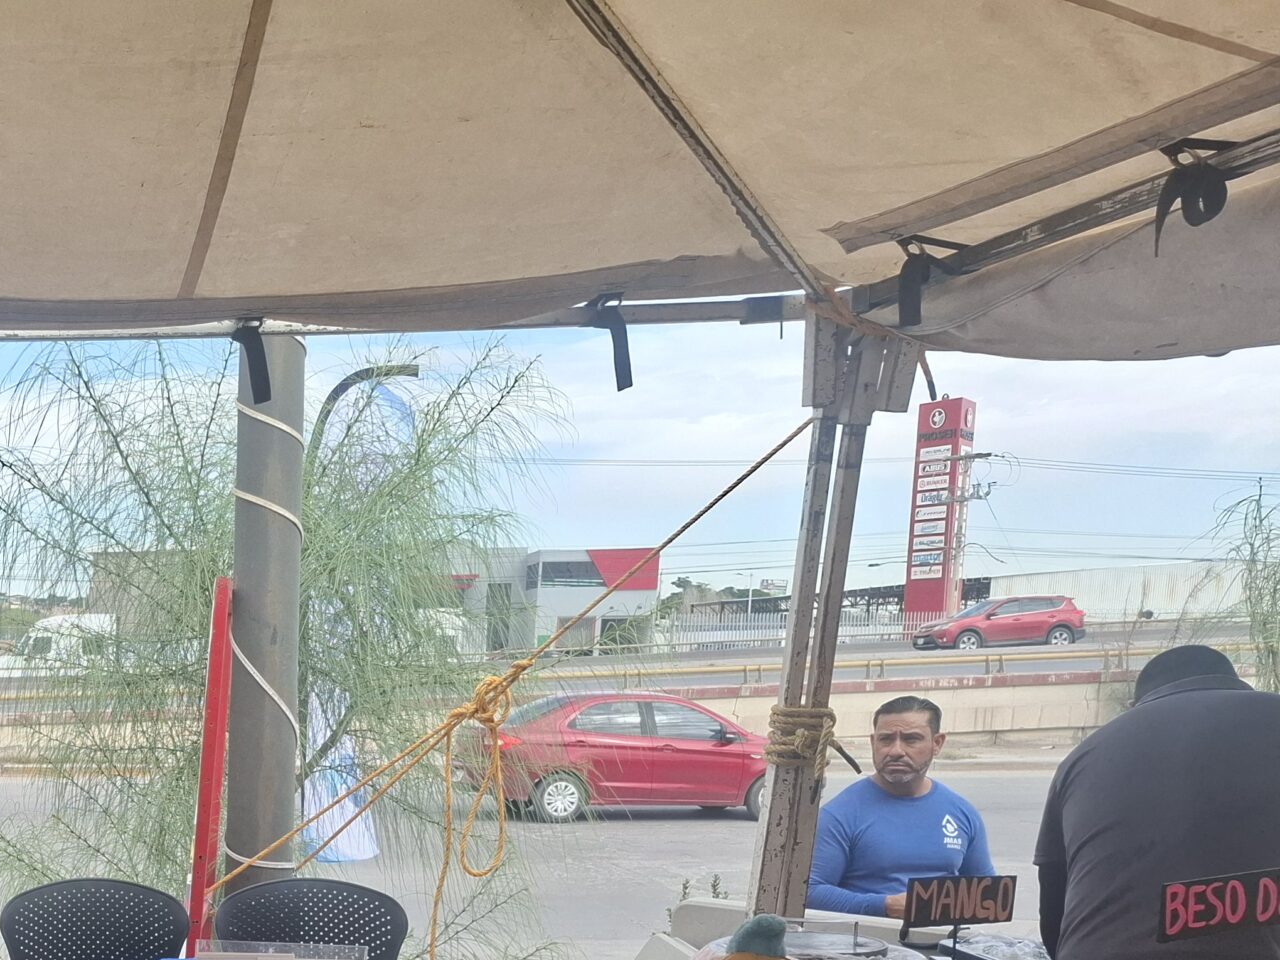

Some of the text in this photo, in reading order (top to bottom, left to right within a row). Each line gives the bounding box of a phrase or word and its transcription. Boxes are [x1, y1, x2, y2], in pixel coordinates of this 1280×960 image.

[910, 876, 1013, 923] MANGO
[1165, 875, 1280, 936] BESO D
